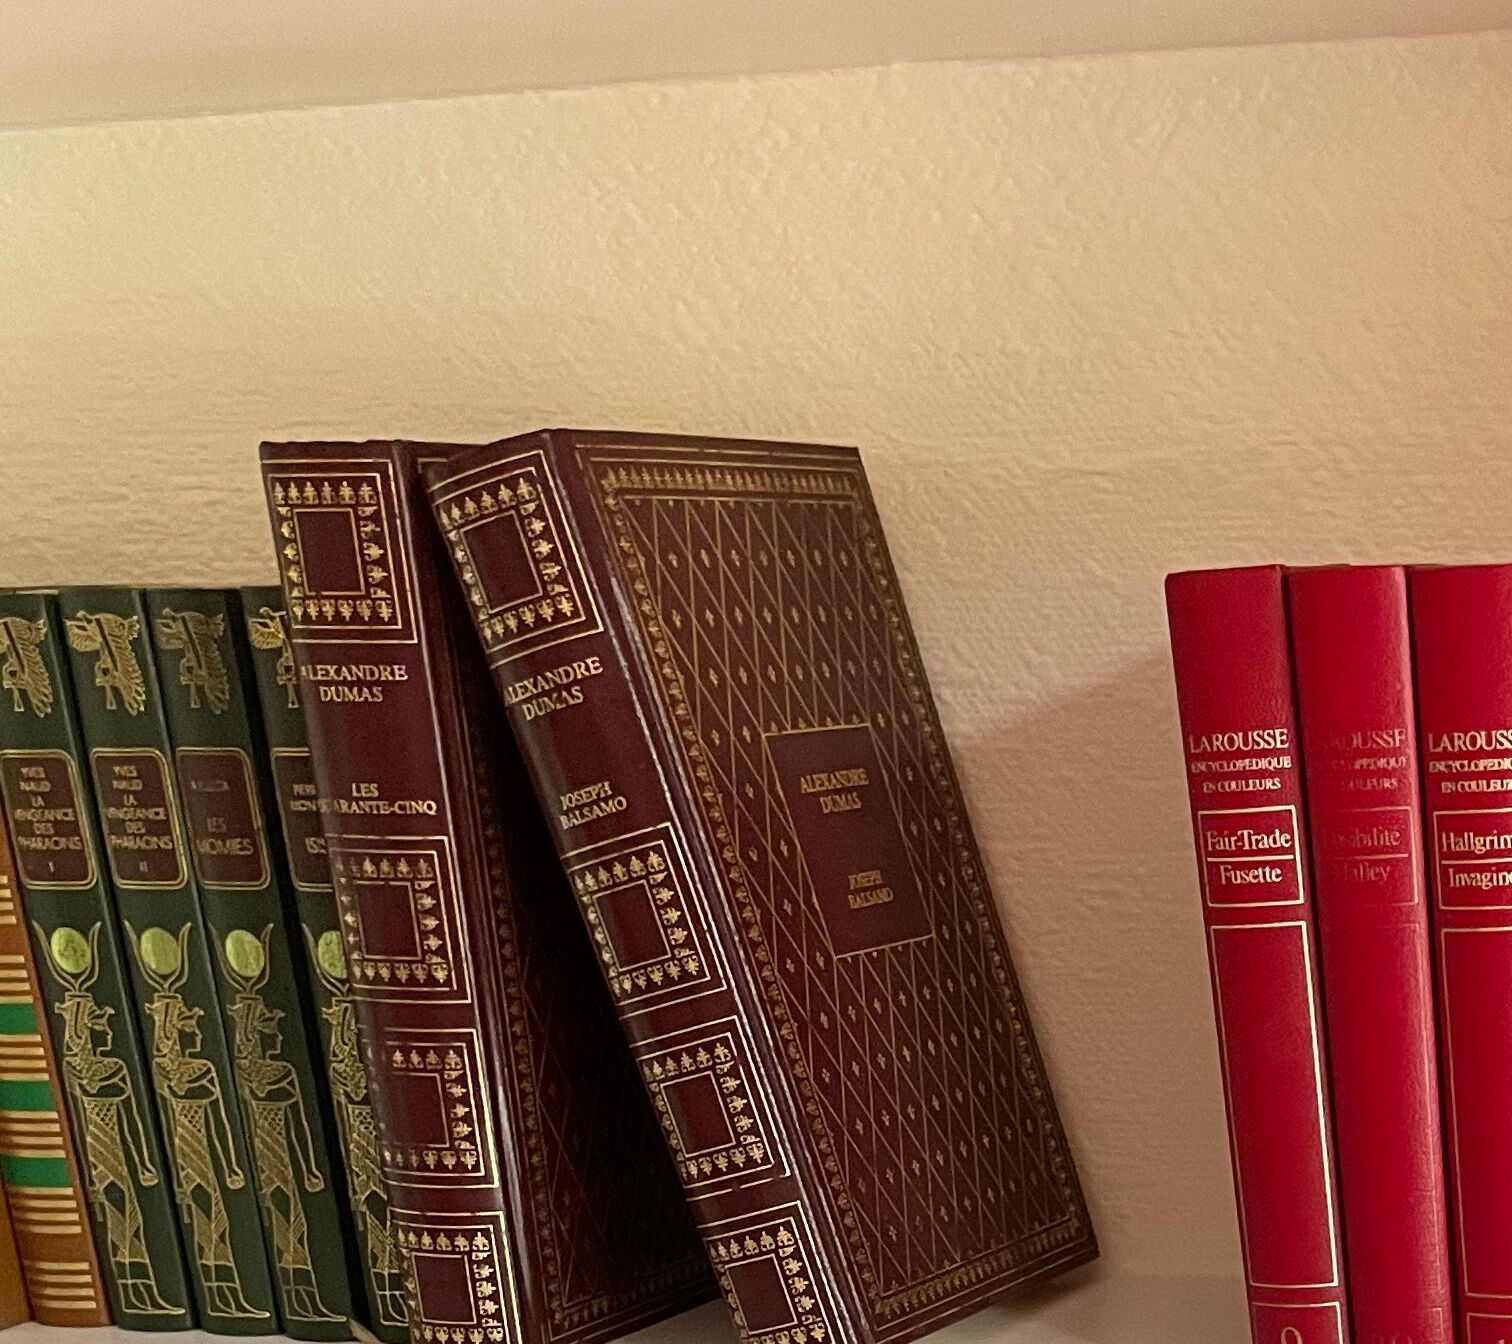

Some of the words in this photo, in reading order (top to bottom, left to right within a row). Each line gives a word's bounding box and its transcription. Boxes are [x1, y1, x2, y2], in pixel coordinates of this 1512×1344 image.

[300, 664, 409, 681] ALEXANDRE
[319, 686, 384, 702] DUMAS
[522, 685, 584, 721] DUMAS
[1190, 729, 1289, 753] LAROUSSE
[351, 783, 379, 798] LES
[800, 768, 869, 794] ALEXANDRE
[1218, 778, 1281, 792] COULEURS
[560, 781, 613, 811] JOSEPH
[560, 796, 627, 830] BALSAMO
[1207, 829, 1291, 851] Fair-Trade
[1220, 865, 1283, 884] Fusette
